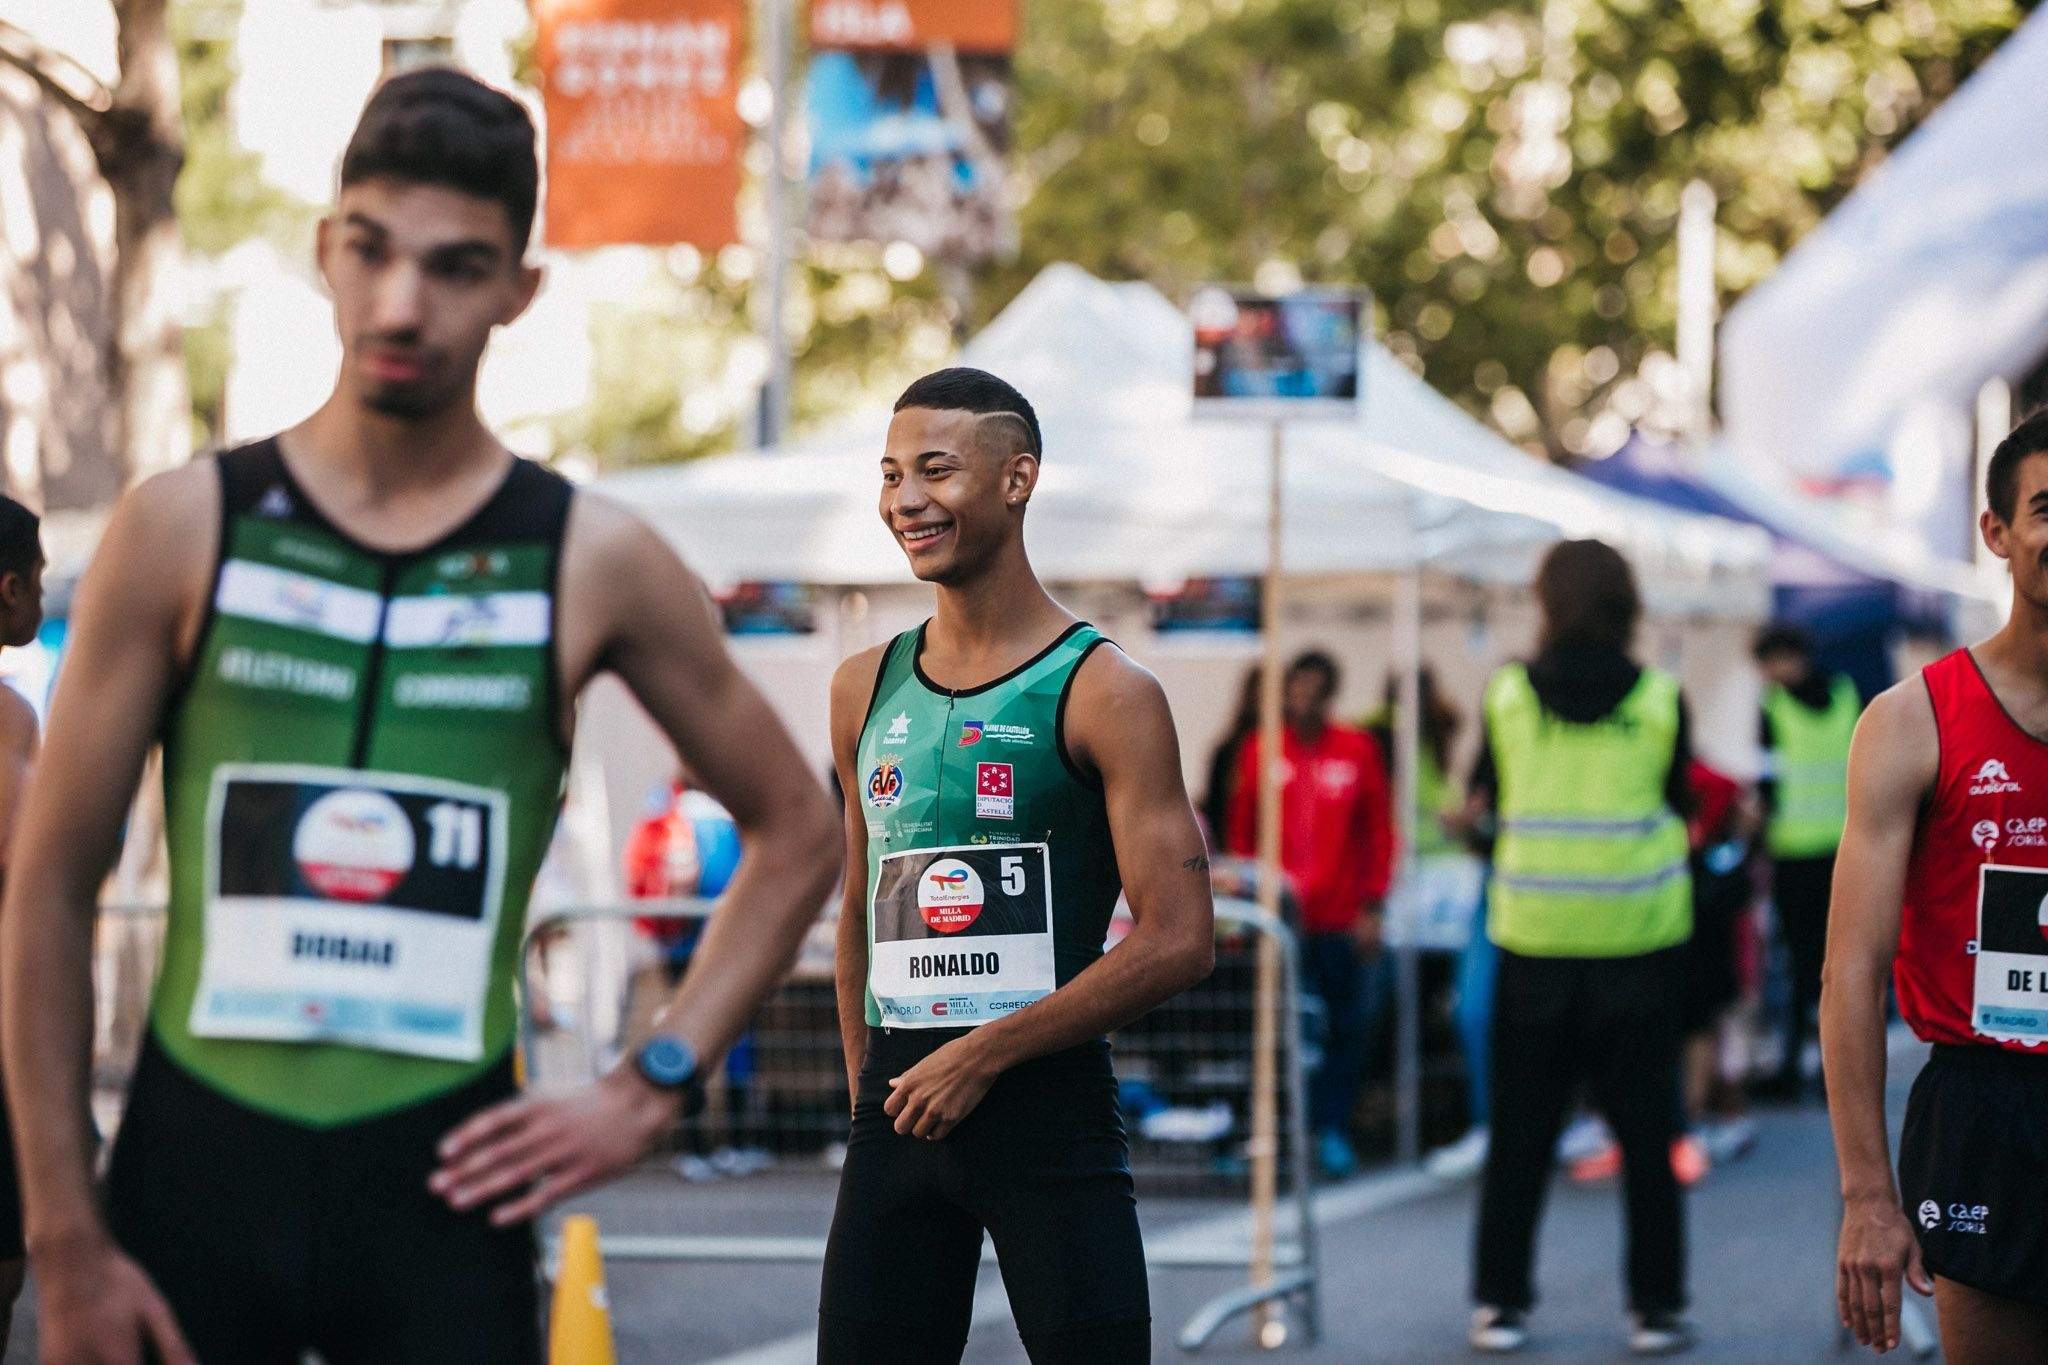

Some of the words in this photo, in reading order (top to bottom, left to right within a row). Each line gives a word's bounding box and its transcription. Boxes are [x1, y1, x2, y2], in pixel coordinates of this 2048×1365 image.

[426, 802, 482, 870] 11
[1001, 856, 1026, 896] 5
[930, 894, 970, 902] TotalEnergies
[940, 907, 962, 915] MILLA
[943, 914, 972, 922] MADRID
[910, 953, 1000, 978] RONALDO
[2008, 970, 2033, 992] DE
